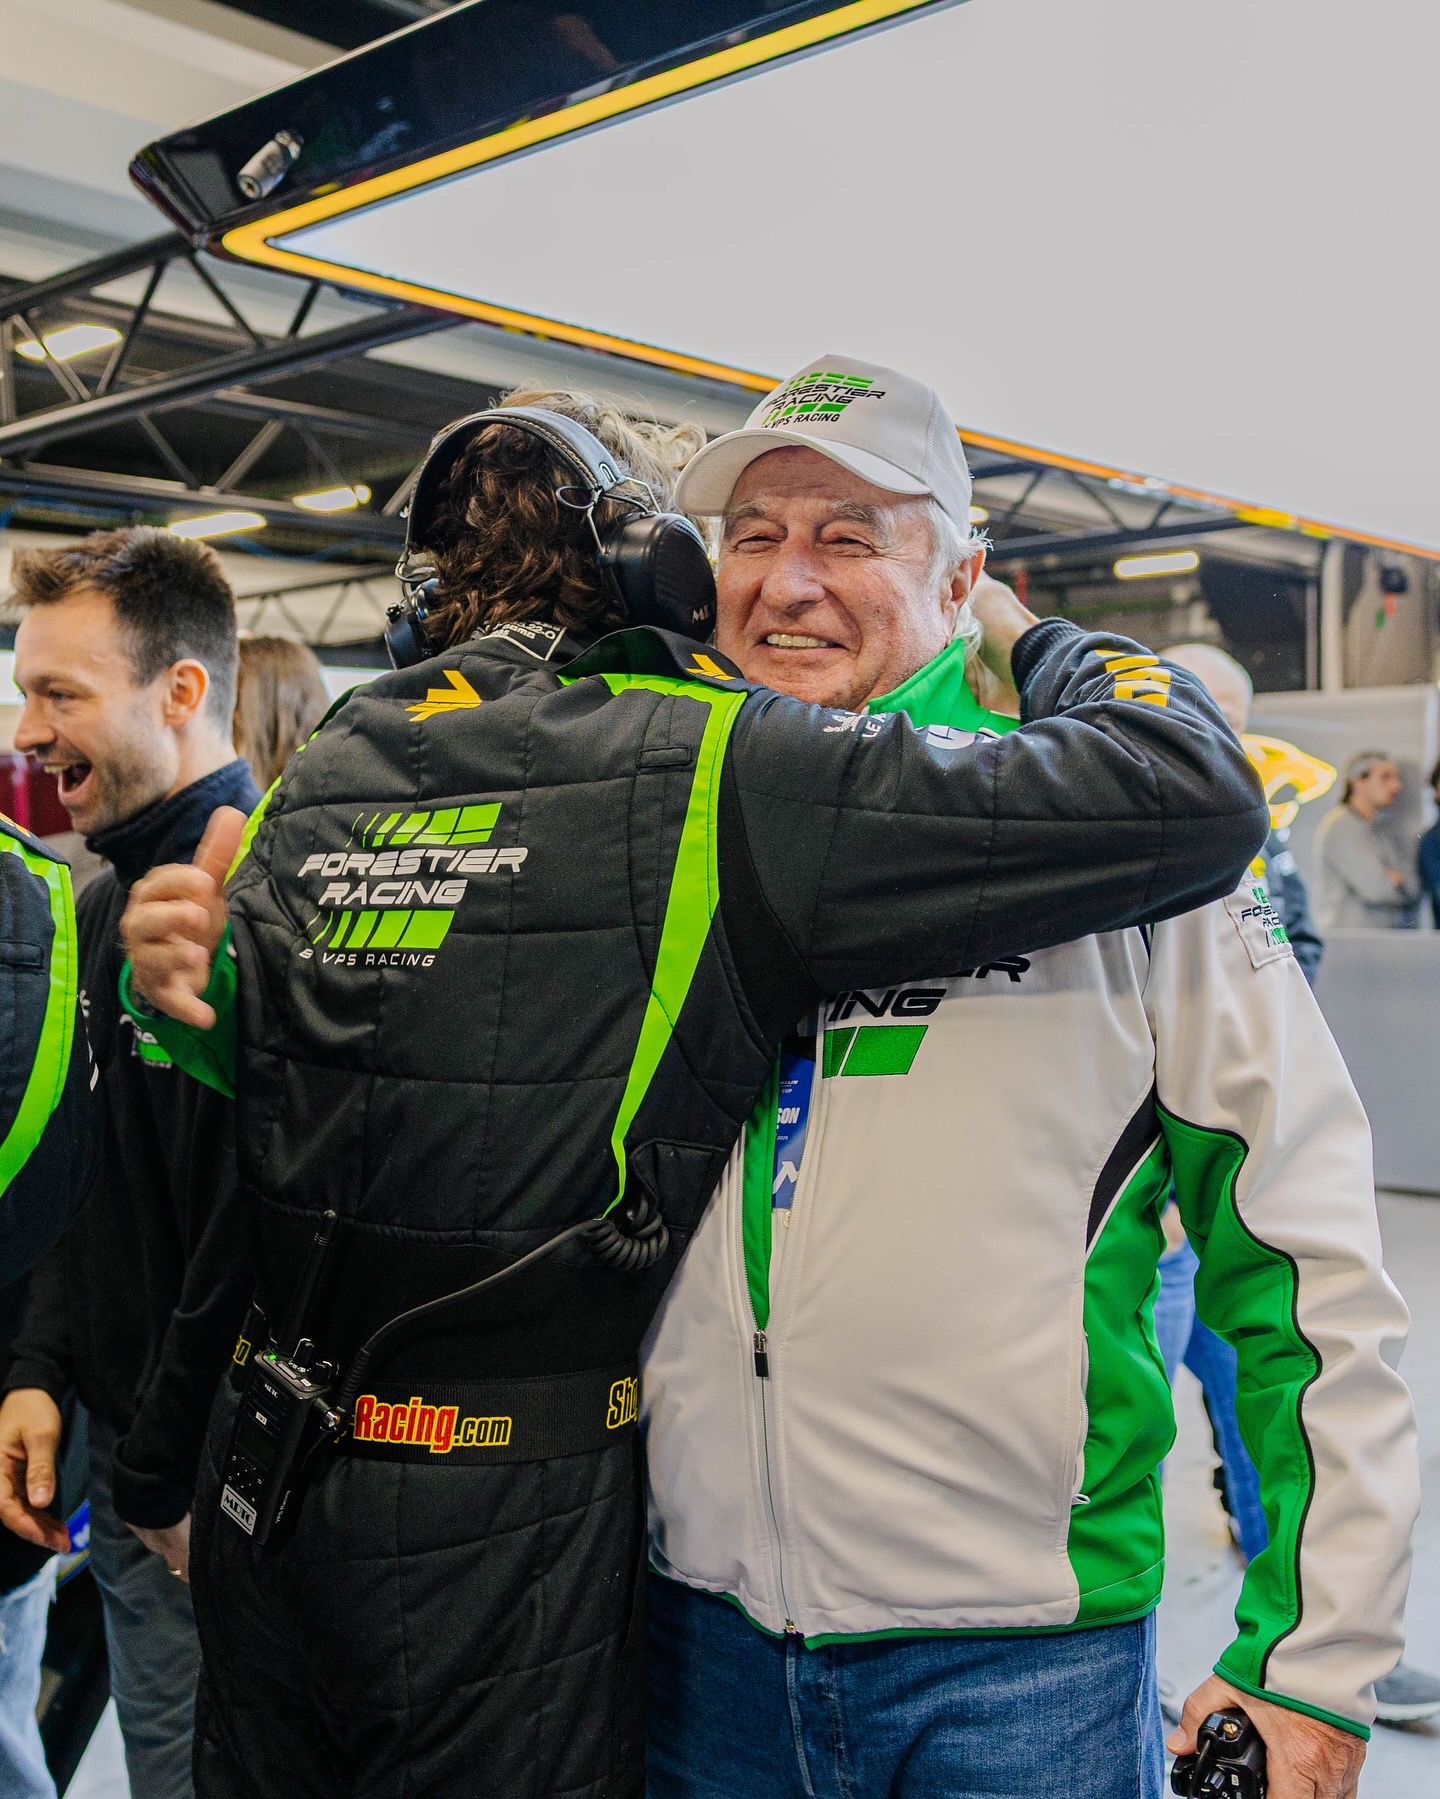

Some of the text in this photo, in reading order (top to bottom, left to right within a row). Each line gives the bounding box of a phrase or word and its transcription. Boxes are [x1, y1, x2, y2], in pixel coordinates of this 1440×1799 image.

[769, 393, 857, 414] RACING
[793, 413, 841, 424] RACING
[297, 847, 529, 877] FORESTIER
[318, 879, 469, 906] RACING
[322, 951, 358, 967] VPS
[365, 953, 436, 968] RACING
